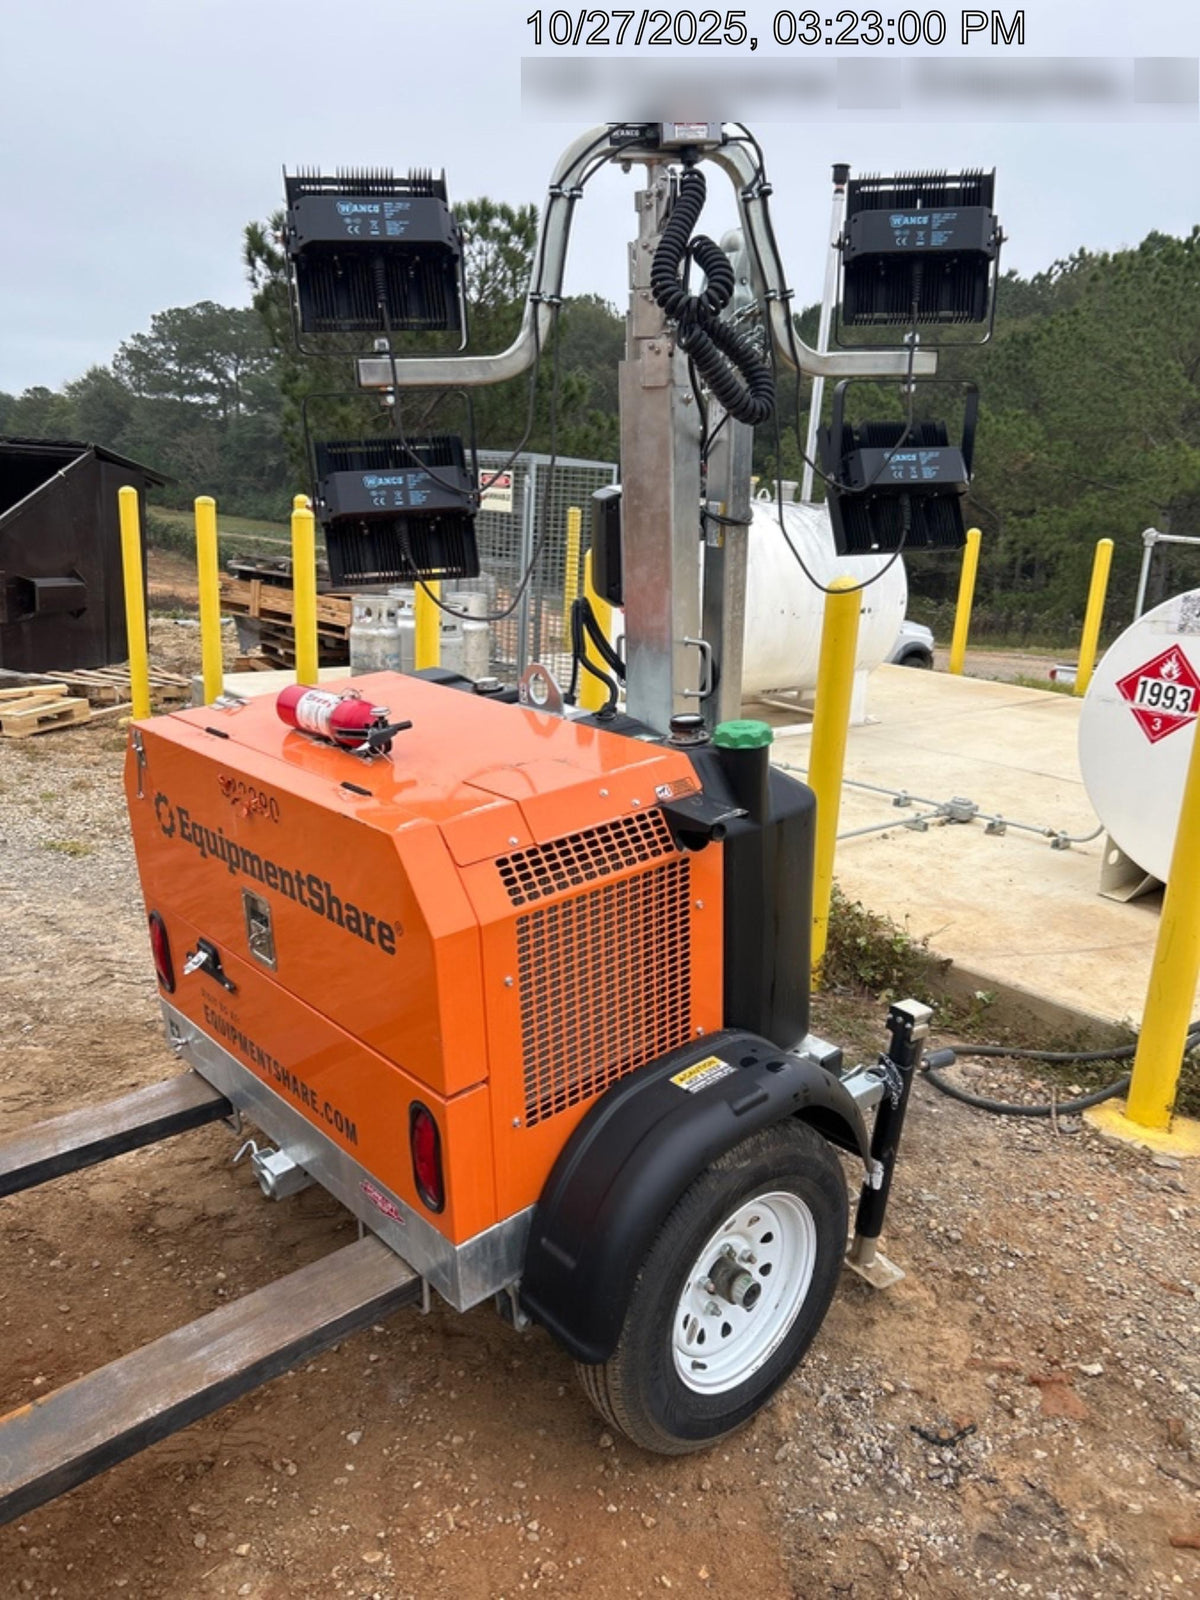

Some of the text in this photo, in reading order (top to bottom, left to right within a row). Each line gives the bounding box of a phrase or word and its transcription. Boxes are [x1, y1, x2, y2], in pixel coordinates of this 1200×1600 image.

[336, 200, 381, 216] WANCO
[890, 213, 930, 228] WANCO
[1138, 679, 1192, 714] 1993
[1151, 717, 1163, 731] 3
[202, 1005, 359, 1145] EQUIPMENTSHARE.COM
